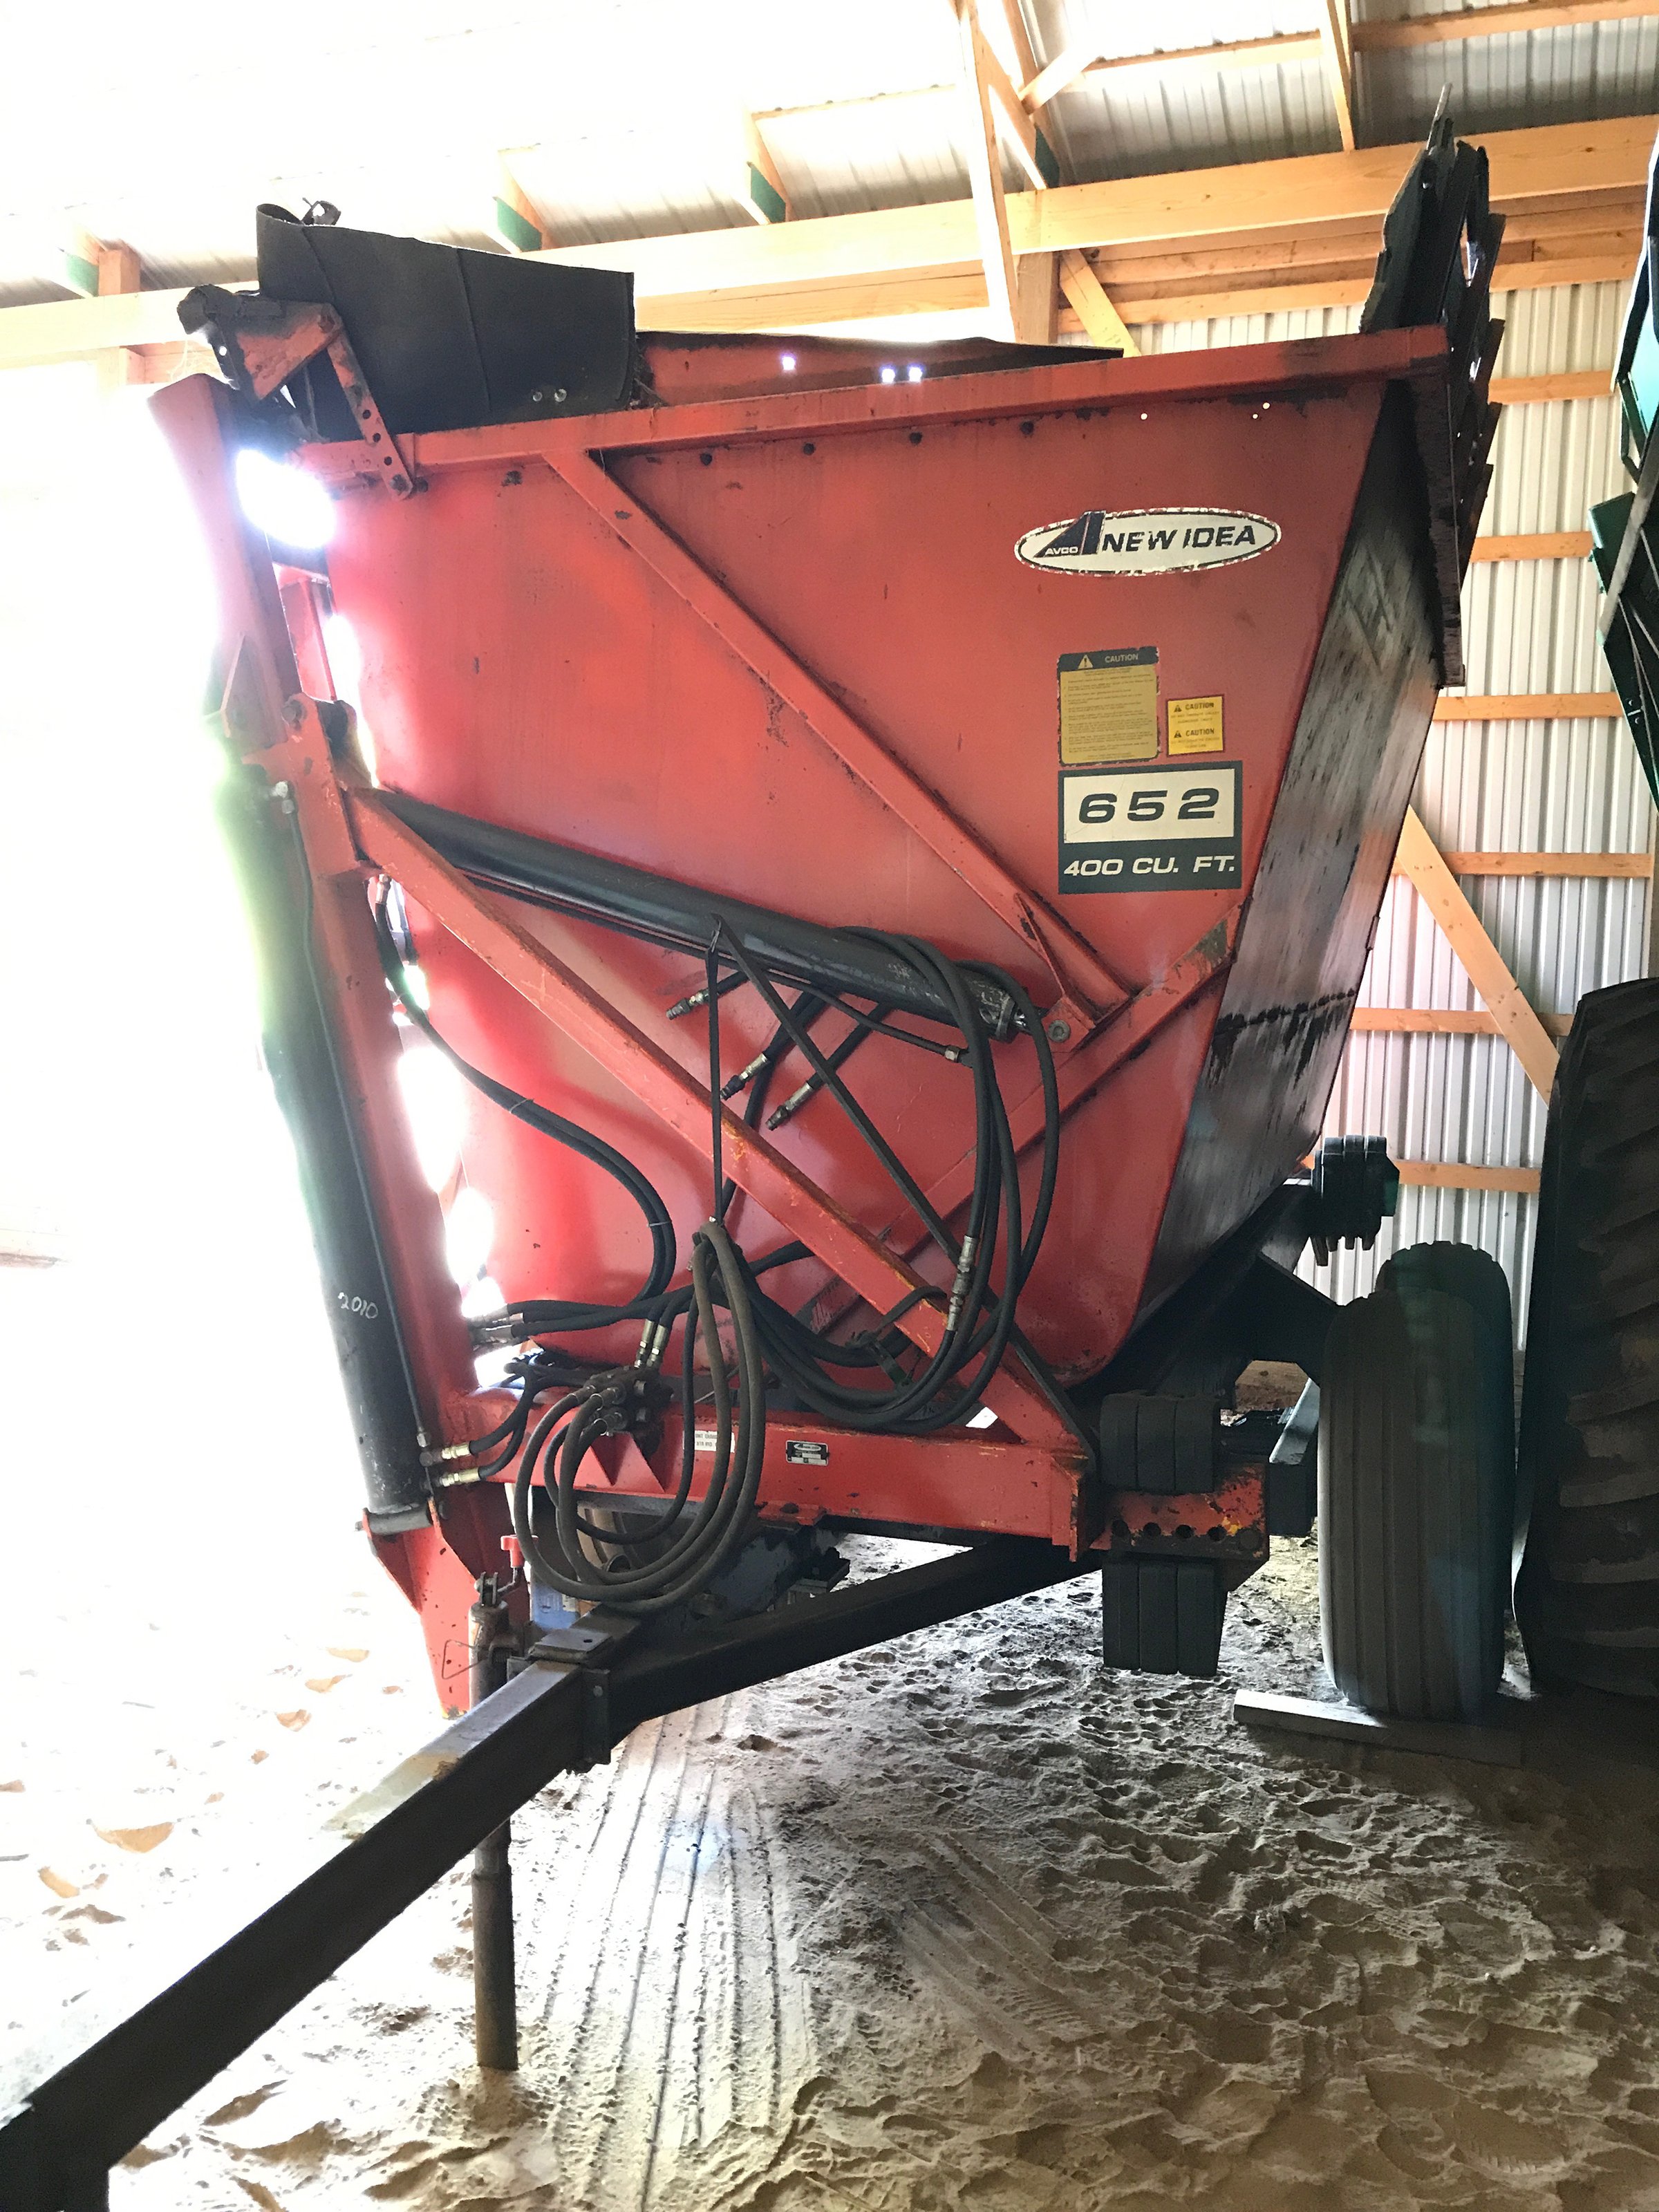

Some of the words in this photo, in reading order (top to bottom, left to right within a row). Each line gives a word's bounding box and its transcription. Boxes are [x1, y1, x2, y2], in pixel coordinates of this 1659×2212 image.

[1102, 529, 1177, 552] NEW
[1183, 525, 1256, 549] IDEA
[1044, 545, 1079, 556] AVCO
[1105, 653, 1139, 663] CAUTION
[1185, 702, 1215, 711] CAUTION
[1185, 728, 1215, 737] CAUTION
[1078, 787, 1220, 824] 652
[1063, 859, 1124, 877] 400
[1132, 857, 1179, 874] CU.
[1192, 855, 1235, 873] FT.
[337, 1292, 379, 1319] 2010
